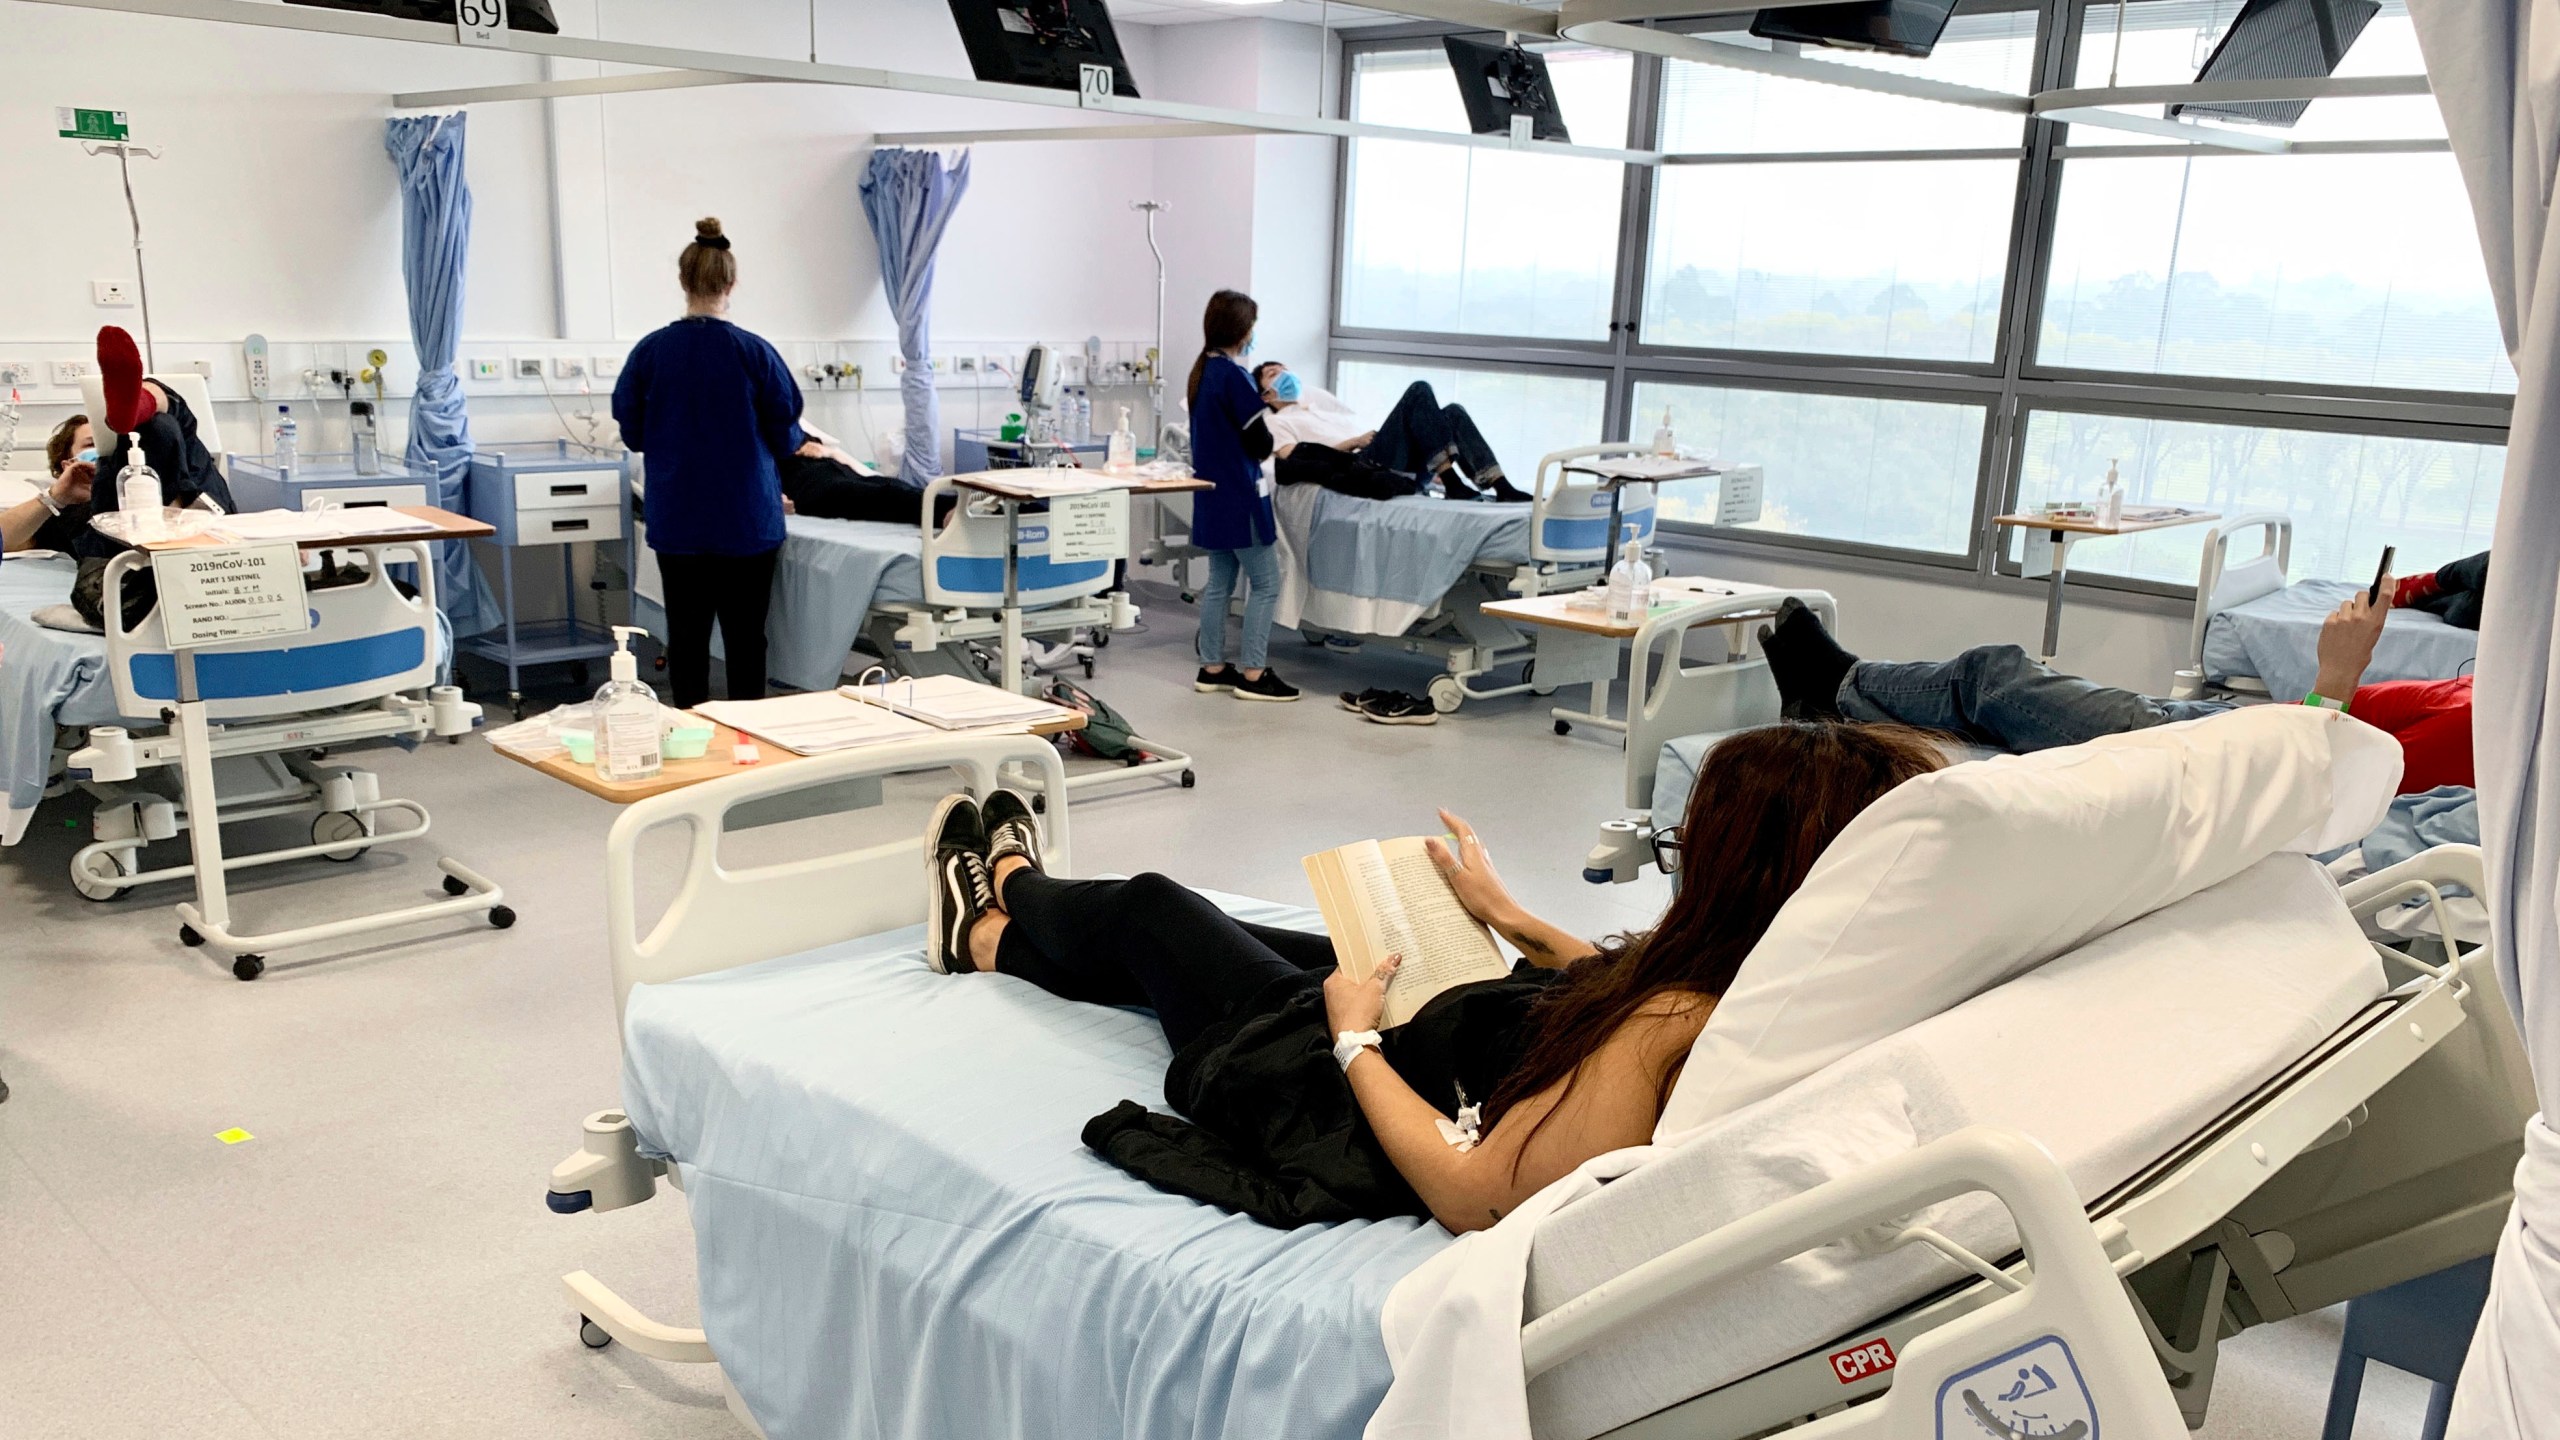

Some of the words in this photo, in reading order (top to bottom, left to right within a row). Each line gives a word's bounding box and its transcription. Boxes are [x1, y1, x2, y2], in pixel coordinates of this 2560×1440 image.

[460, 0, 501, 28] 69
[1083, 67, 1109, 95] 70
[190, 557, 266, 573] 2019nCoV-101
[201, 577, 219, 585] PART
[221, 575, 226, 583] 1
[227, 573, 261, 582] SENTINEL
[184, 602, 208, 610] Screen
[192, 616, 213, 624] RAND
[192, 630, 218, 640] Dosing
[1836, 1344, 1893, 1378] CPR
